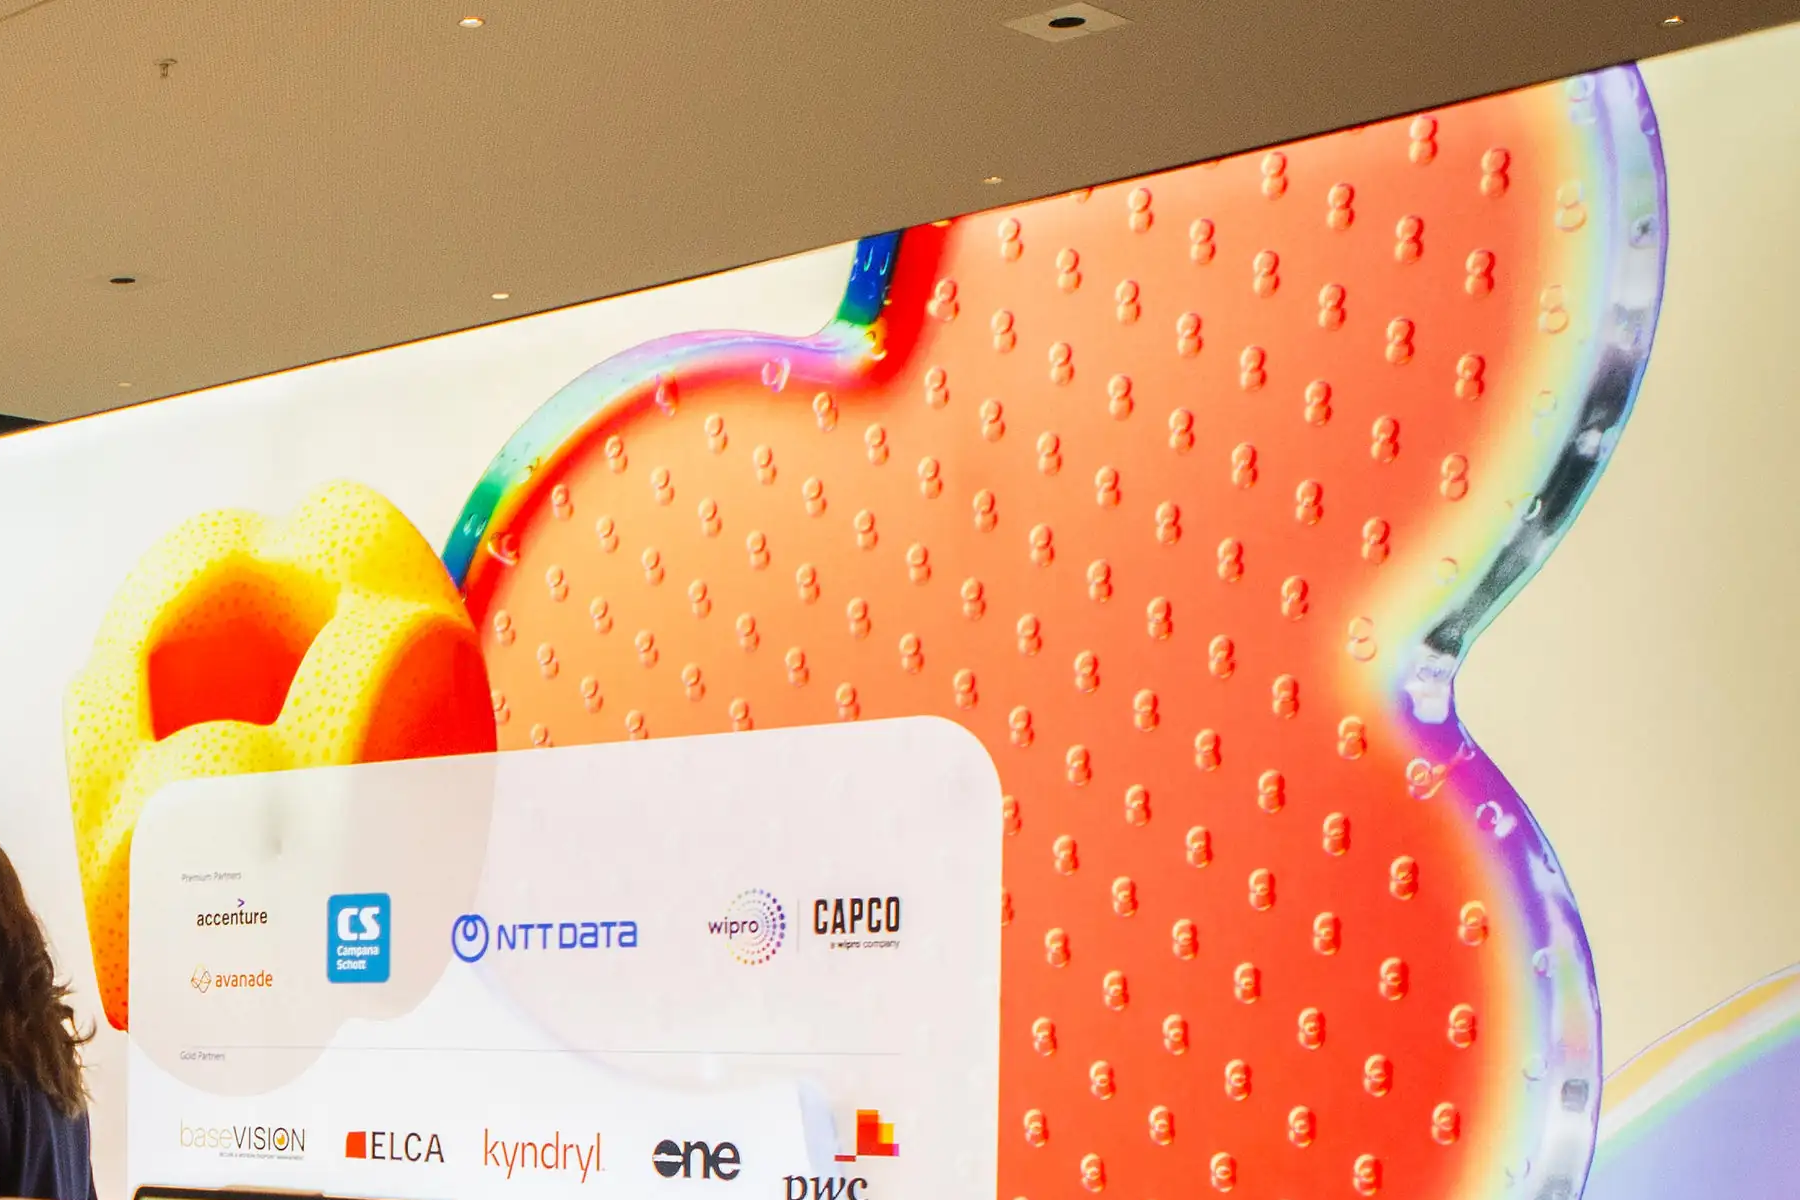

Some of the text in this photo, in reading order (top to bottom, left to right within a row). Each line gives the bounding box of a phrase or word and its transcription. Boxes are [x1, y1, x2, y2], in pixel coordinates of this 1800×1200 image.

[197, 910, 267, 926] accenture
[337, 906, 380, 941] CS
[814, 897, 899, 934] CAPCO
[498, 923, 553, 950] NTT
[709, 917, 758, 939] wipro
[337, 945, 379, 957] Campana
[862, 941, 900, 949] company
[337, 959, 367, 970] Schott
[216, 970, 272, 987] avanade
[180, 1118, 305, 1152] baseVISION
[371, 1132, 444, 1163] ELCA
[484, 1128, 600, 1183] kyndryl
